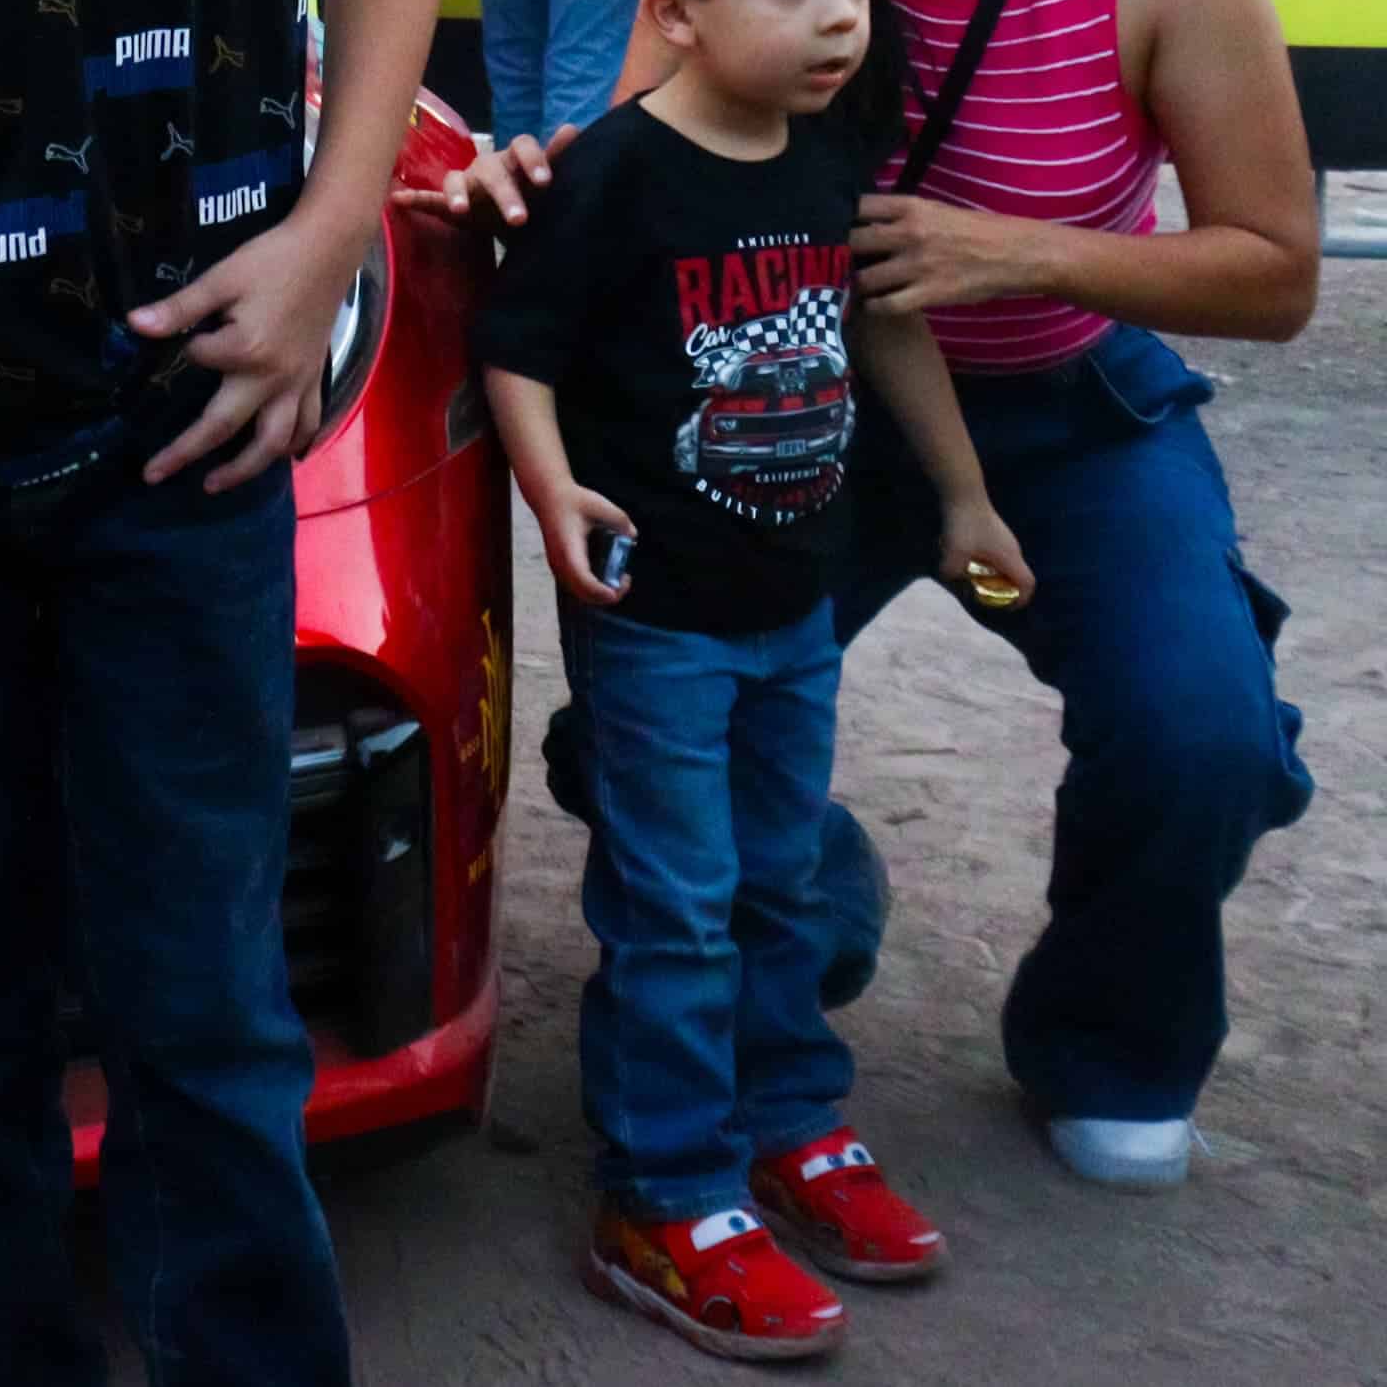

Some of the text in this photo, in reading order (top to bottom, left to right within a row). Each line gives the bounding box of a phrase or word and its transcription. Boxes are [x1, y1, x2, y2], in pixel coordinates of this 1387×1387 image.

[115, 28, 190, 67] PUMA
[198, 181, 267, 225] PUMA
[695, 477, 759, 520] BUILT
